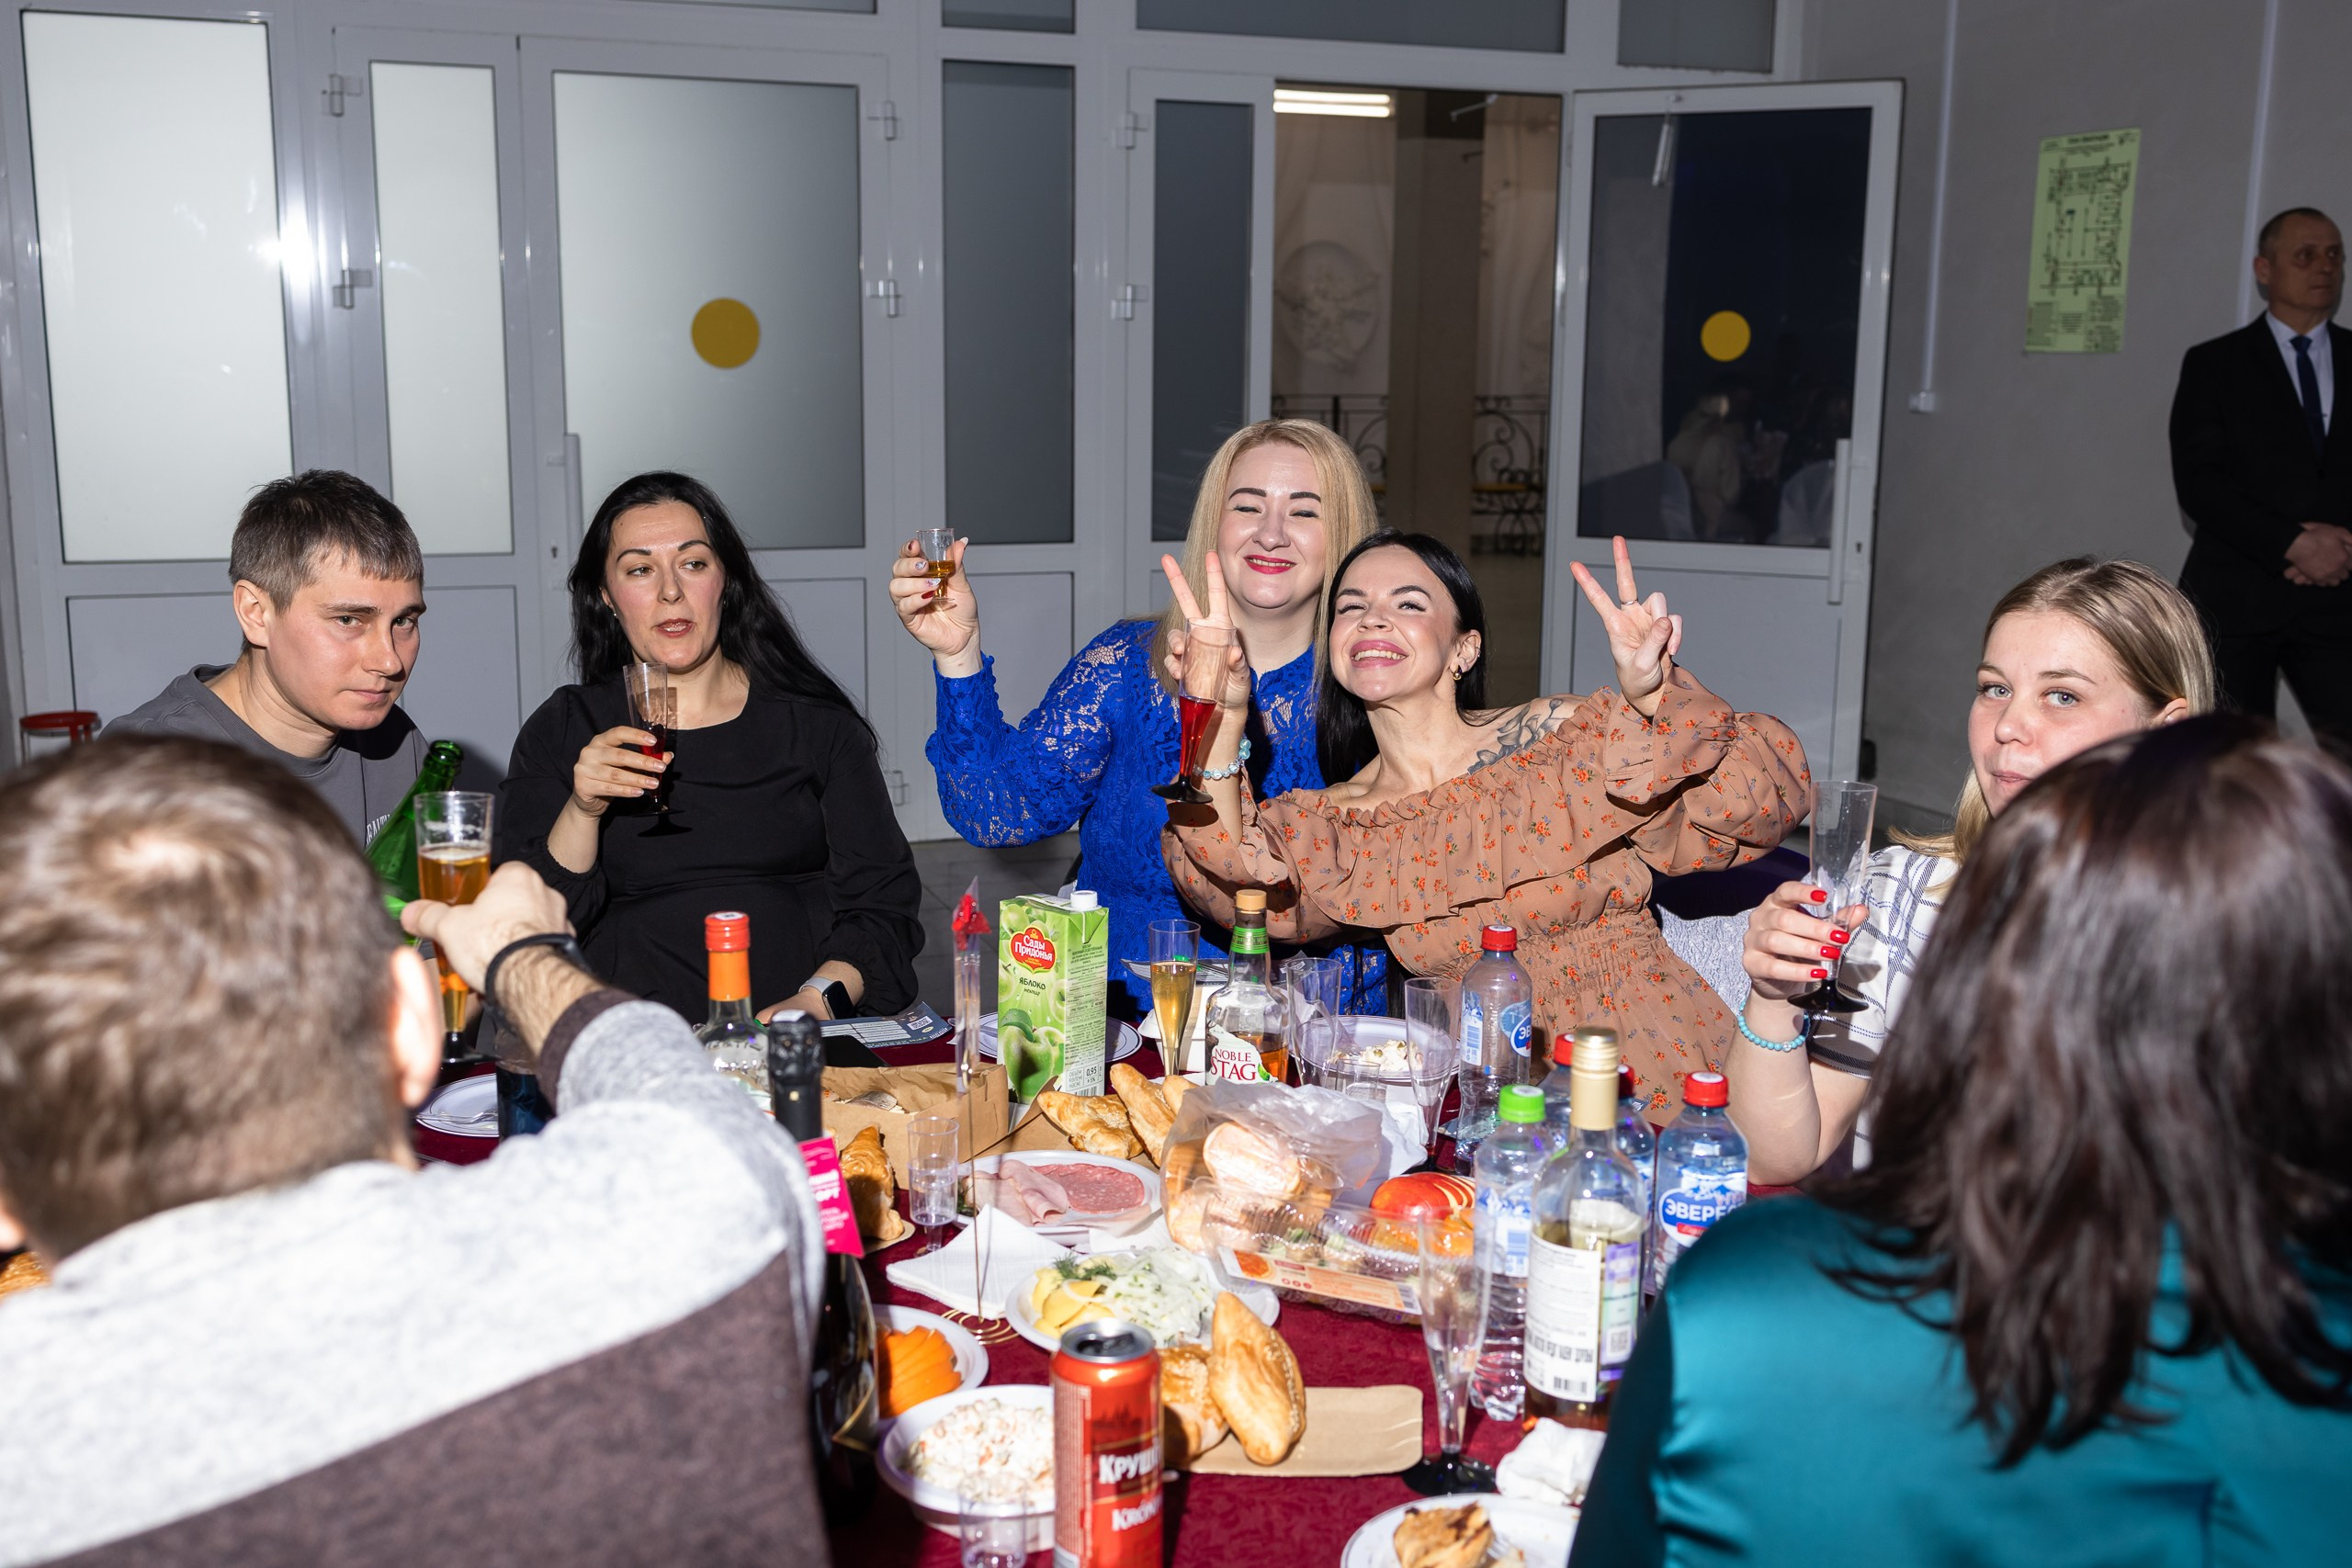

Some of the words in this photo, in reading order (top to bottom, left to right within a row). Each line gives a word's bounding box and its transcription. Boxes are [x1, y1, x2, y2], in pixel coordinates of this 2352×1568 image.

[1023, 935, 1046, 951] Сады
[1014, 942, 1053, 962] Придонья
[1019, 976, 1046, 990] ЯБЛОКО
[1215, 1048, 1251, 1063] NOBLE
[1086, 1066, 1097, 1077] 0,95
[1210, 1055, 1257, 1081] STAG
